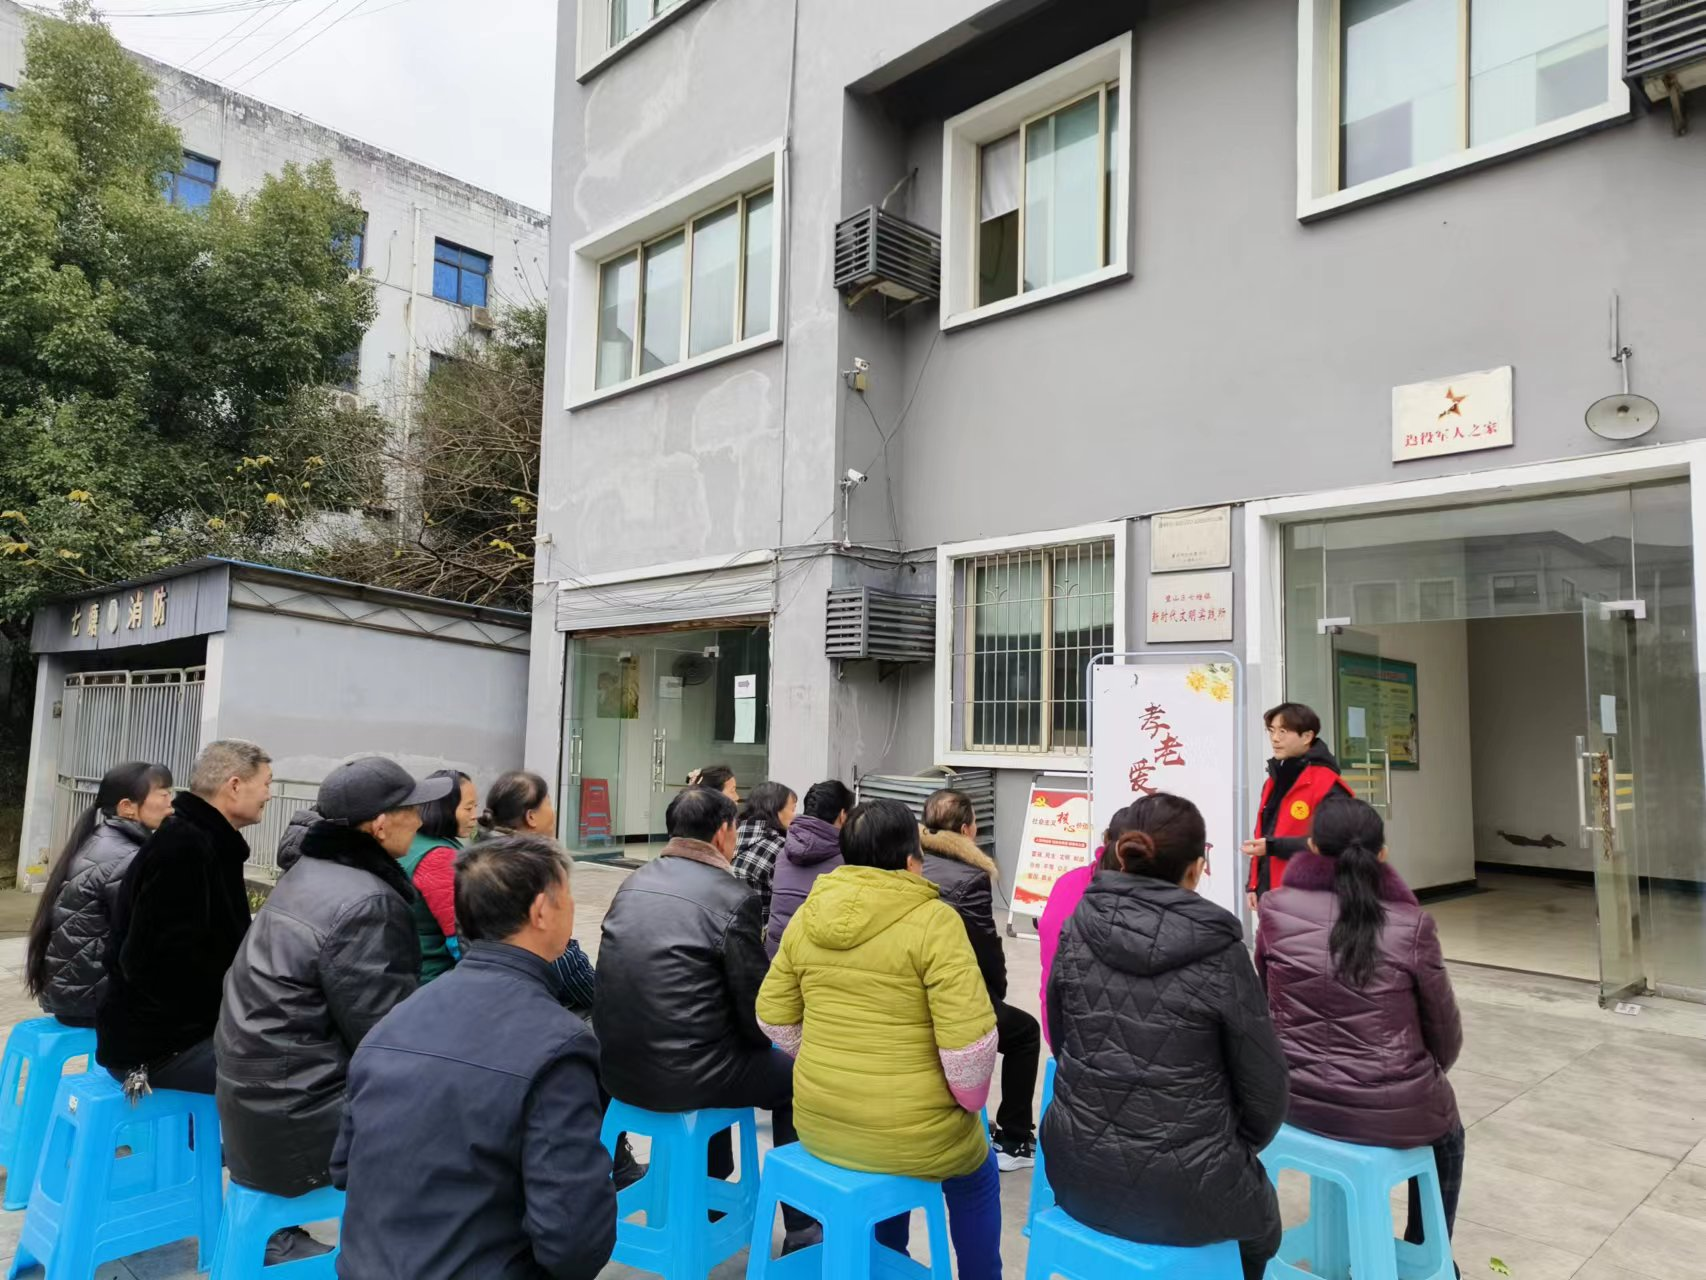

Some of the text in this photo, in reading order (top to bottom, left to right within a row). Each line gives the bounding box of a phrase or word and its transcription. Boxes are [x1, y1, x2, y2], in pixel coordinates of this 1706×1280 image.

[127, 586, 168, 629] 消防
[1152, 607, 1226, 623] 新时代文明实践所
